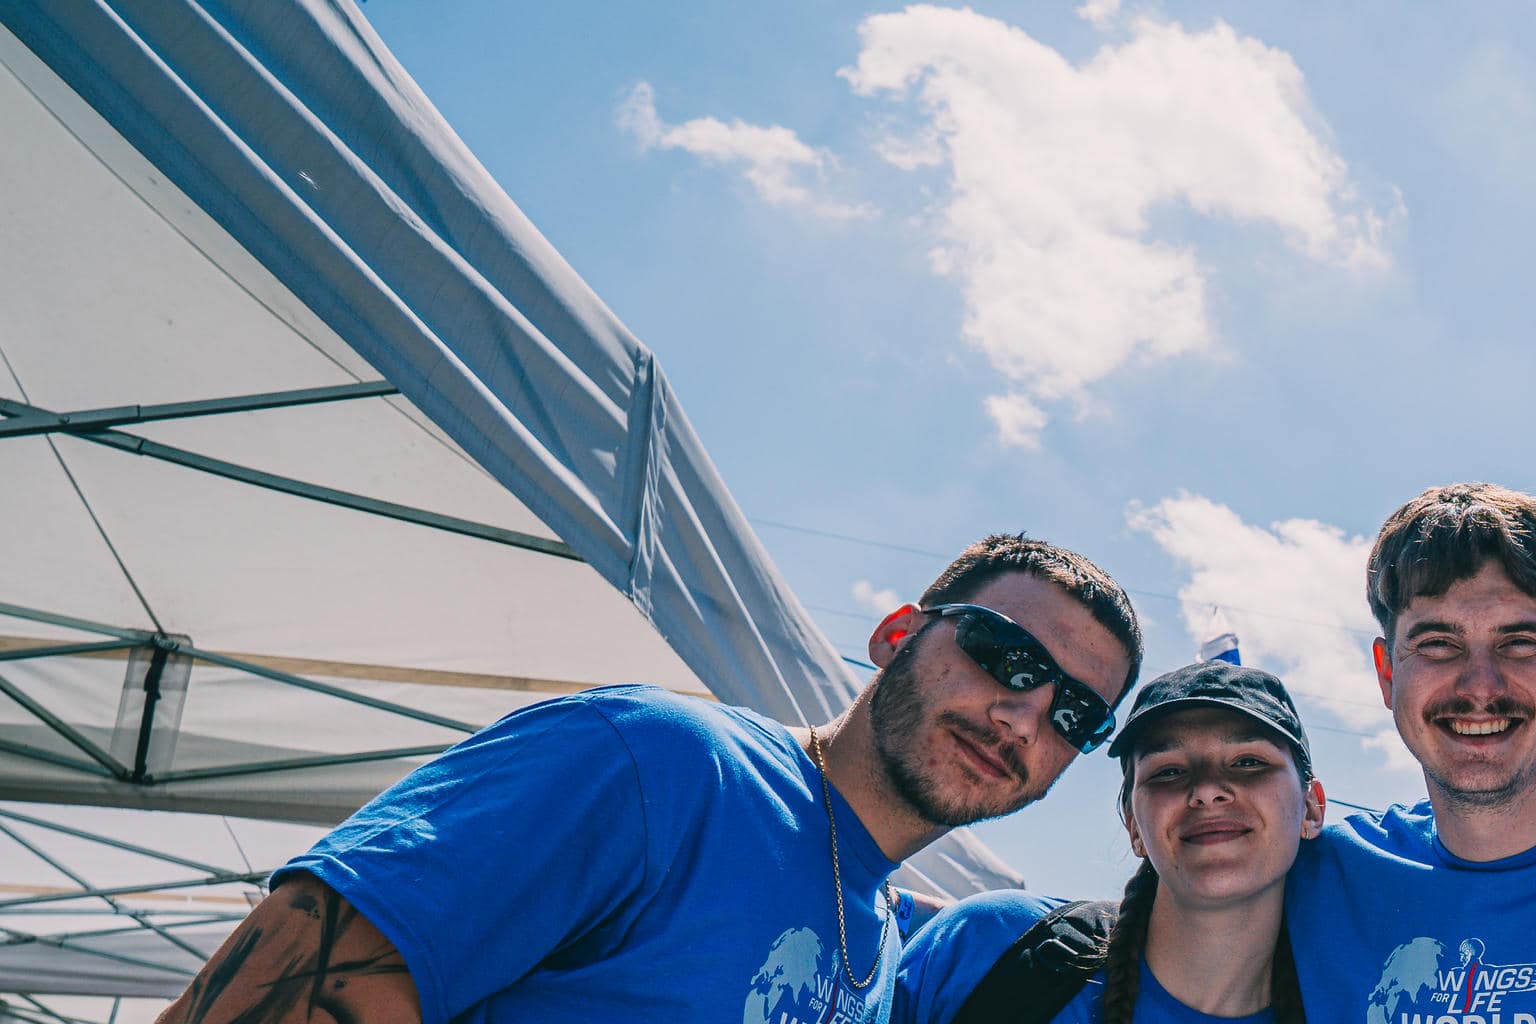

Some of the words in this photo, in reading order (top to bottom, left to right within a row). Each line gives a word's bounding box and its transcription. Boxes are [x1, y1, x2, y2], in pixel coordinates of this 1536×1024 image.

[1439, 967, 1534, 992] WINGS
[808, 997, 823, 1012] FOR
[816, 974, 865, 1023] WINGS
[1430, 992, 1450, 1004] FOR
[1447, 991, 1507, 1014] LIFE
